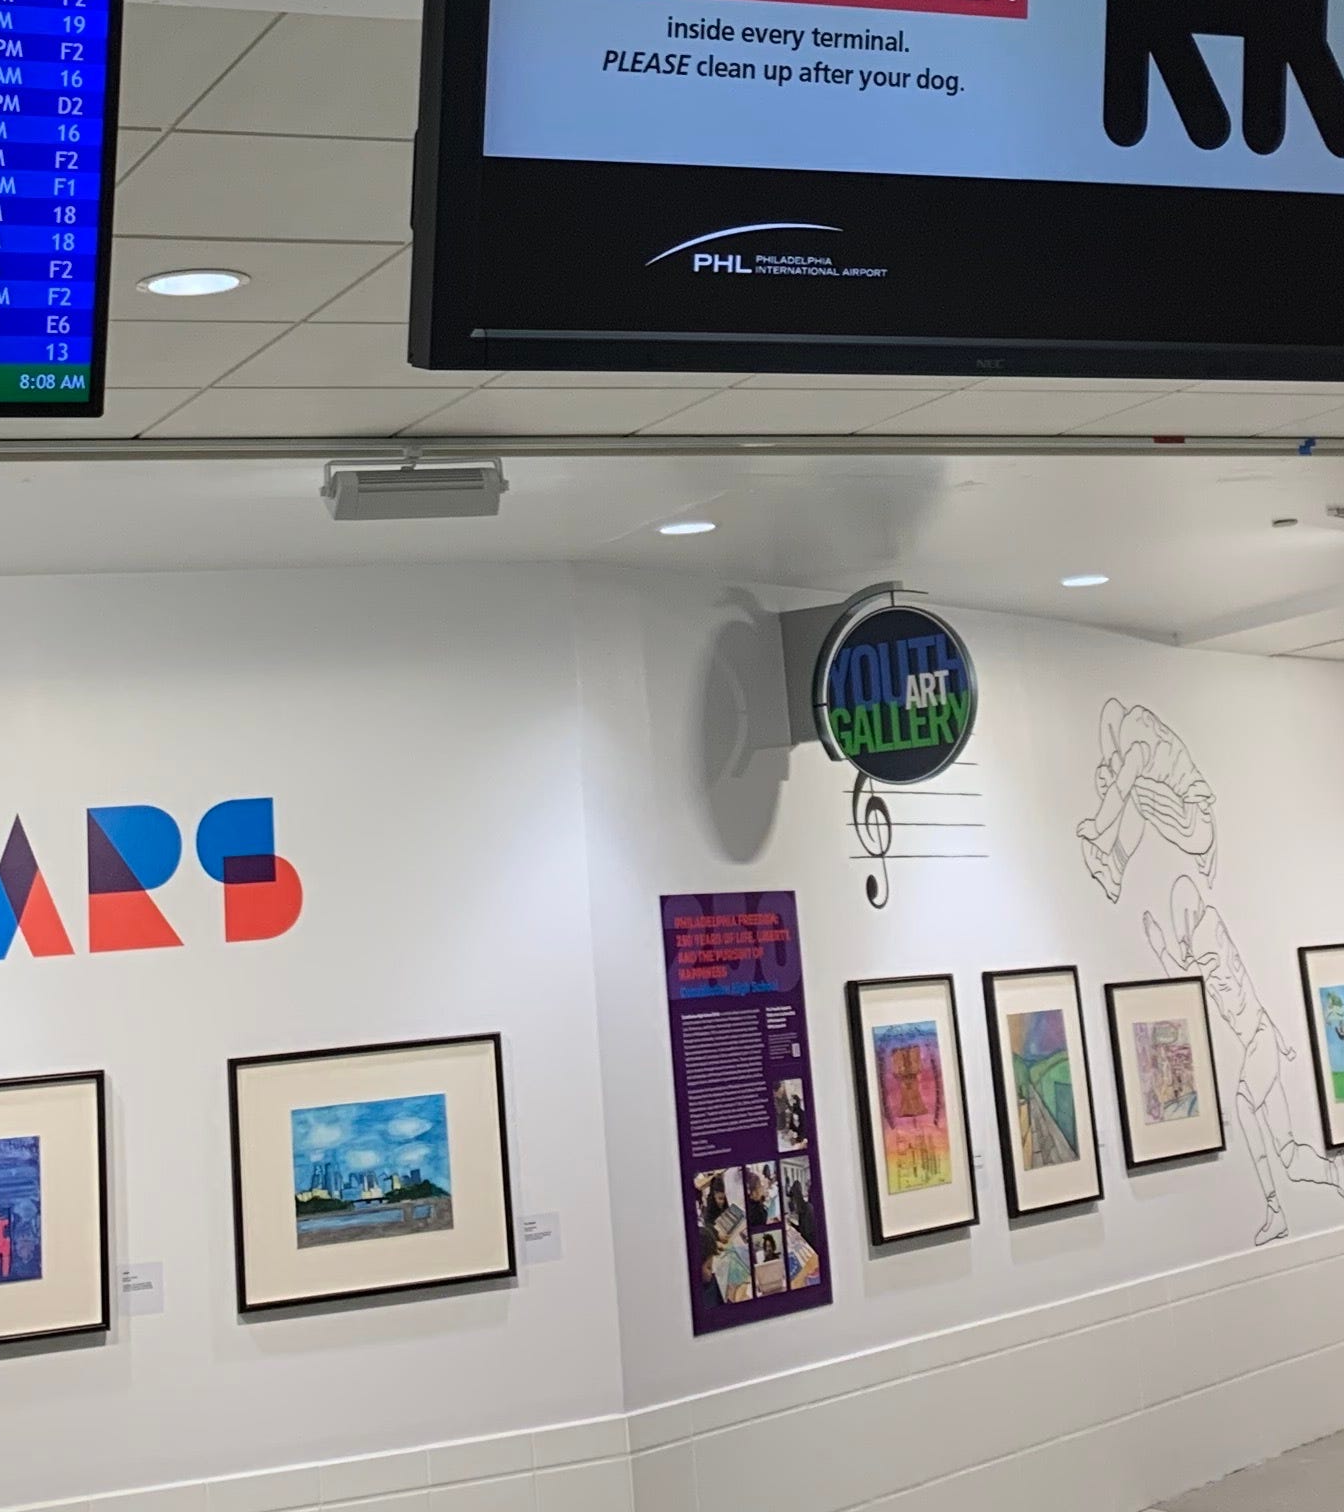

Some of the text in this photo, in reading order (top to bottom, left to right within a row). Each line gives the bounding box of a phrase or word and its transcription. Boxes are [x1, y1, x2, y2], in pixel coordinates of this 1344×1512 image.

[63, 16, 86, 33] 19
[668, 16, 909, 52] inside every terminal.
[603, 50, 964, 96] PLEASE clean up after your dog.
[693, 253, 753, 274] PHL
[755, 254, 833, 266] PHILADELPHIA
[755, 265, 889, 278] INTERNATIONAL AIRPORT
[47, 316, 70, 334] E6
[830, 633, 969, 710] YOUTH
[905, 669, 949, 710] ART
[830, 690, 969, 756] GALLERY
